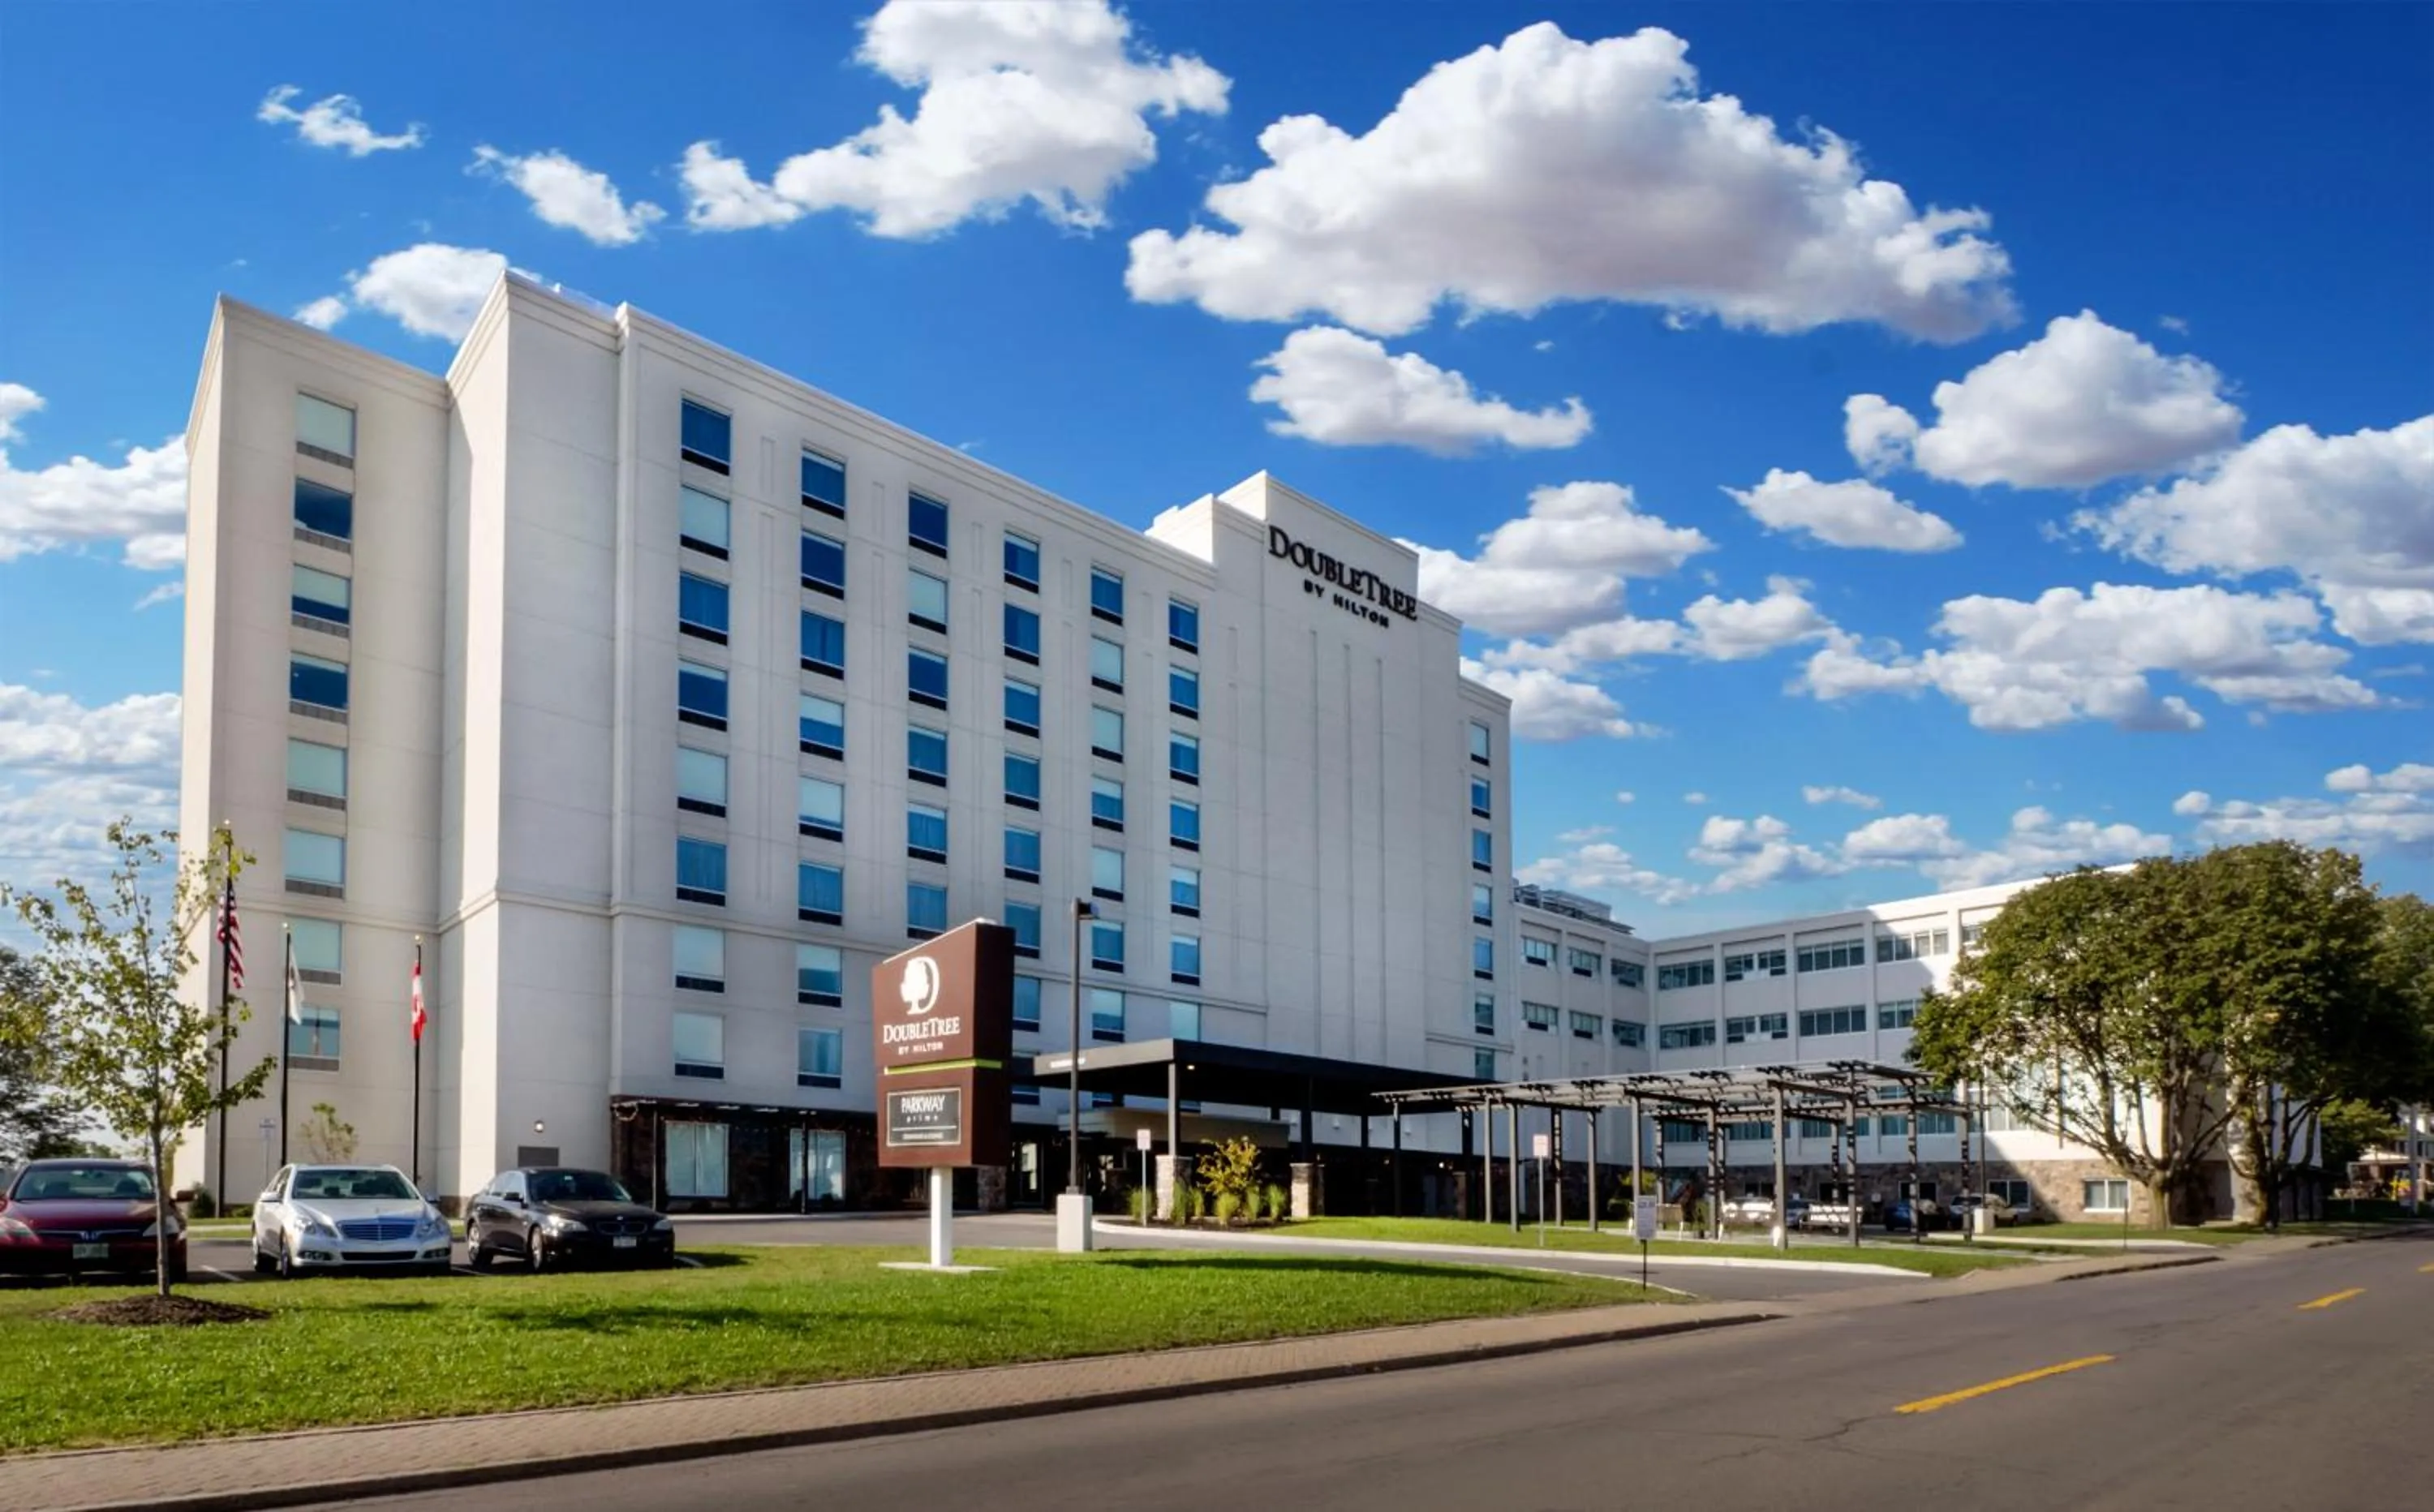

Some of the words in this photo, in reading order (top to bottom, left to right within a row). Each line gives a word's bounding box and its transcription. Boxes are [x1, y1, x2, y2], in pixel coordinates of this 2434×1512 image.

[1269, 525, 1417, 621] DOUBLETREE
[1304, 578, 1325, 598] BY
[1333, 593, 1390, 629] HILTON
[883, 1016, 961, 1045] DOUBLETREE
[898, 1046, 910, 1055] BY
[913, 1042, 944, 1053] HILTON
[901, 1095, 946, 1114] PARKWAY
